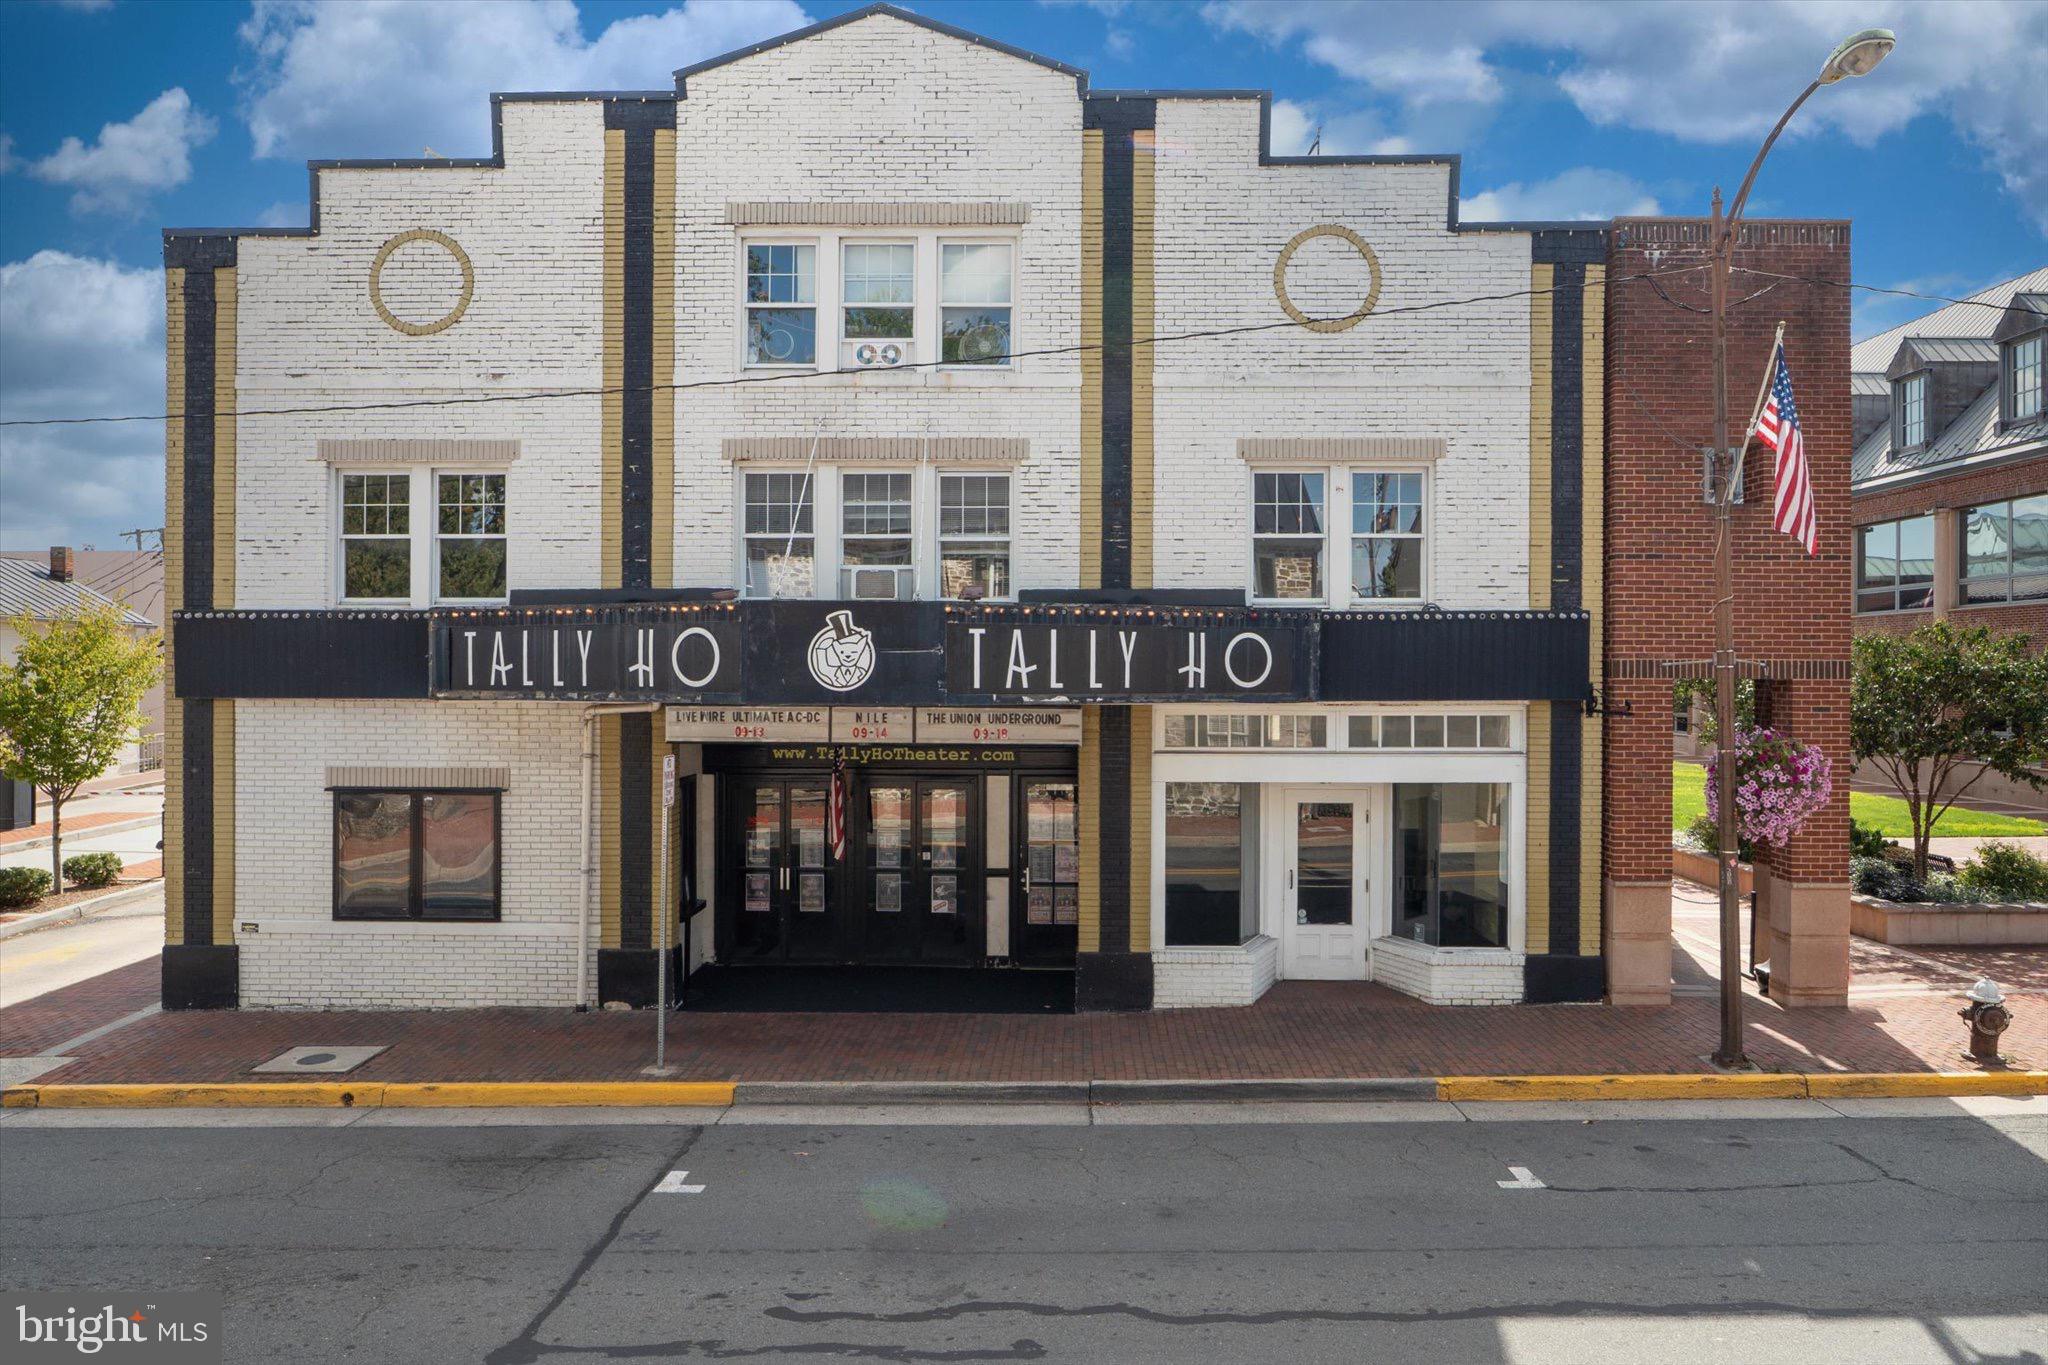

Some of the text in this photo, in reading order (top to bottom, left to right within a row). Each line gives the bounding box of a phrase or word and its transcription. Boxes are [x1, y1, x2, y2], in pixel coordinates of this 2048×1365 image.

[464, 626, 720, 688] TALLY HO
[968, 628, 1273, 689] TALLY HO
[732, 711, 784, 724] ULTIMATE
[855, 712, 888, 724] NILE
[927, 712, 1061, 725] THE UNION UNDERGROUND
[734, 726, 765, 738] 09-13
[852, 727, 888, 739] 09-14
[973, 728, 1008, 740] 09-18
[772, 747, 1015, 764] www.TallyHoTheater.com
